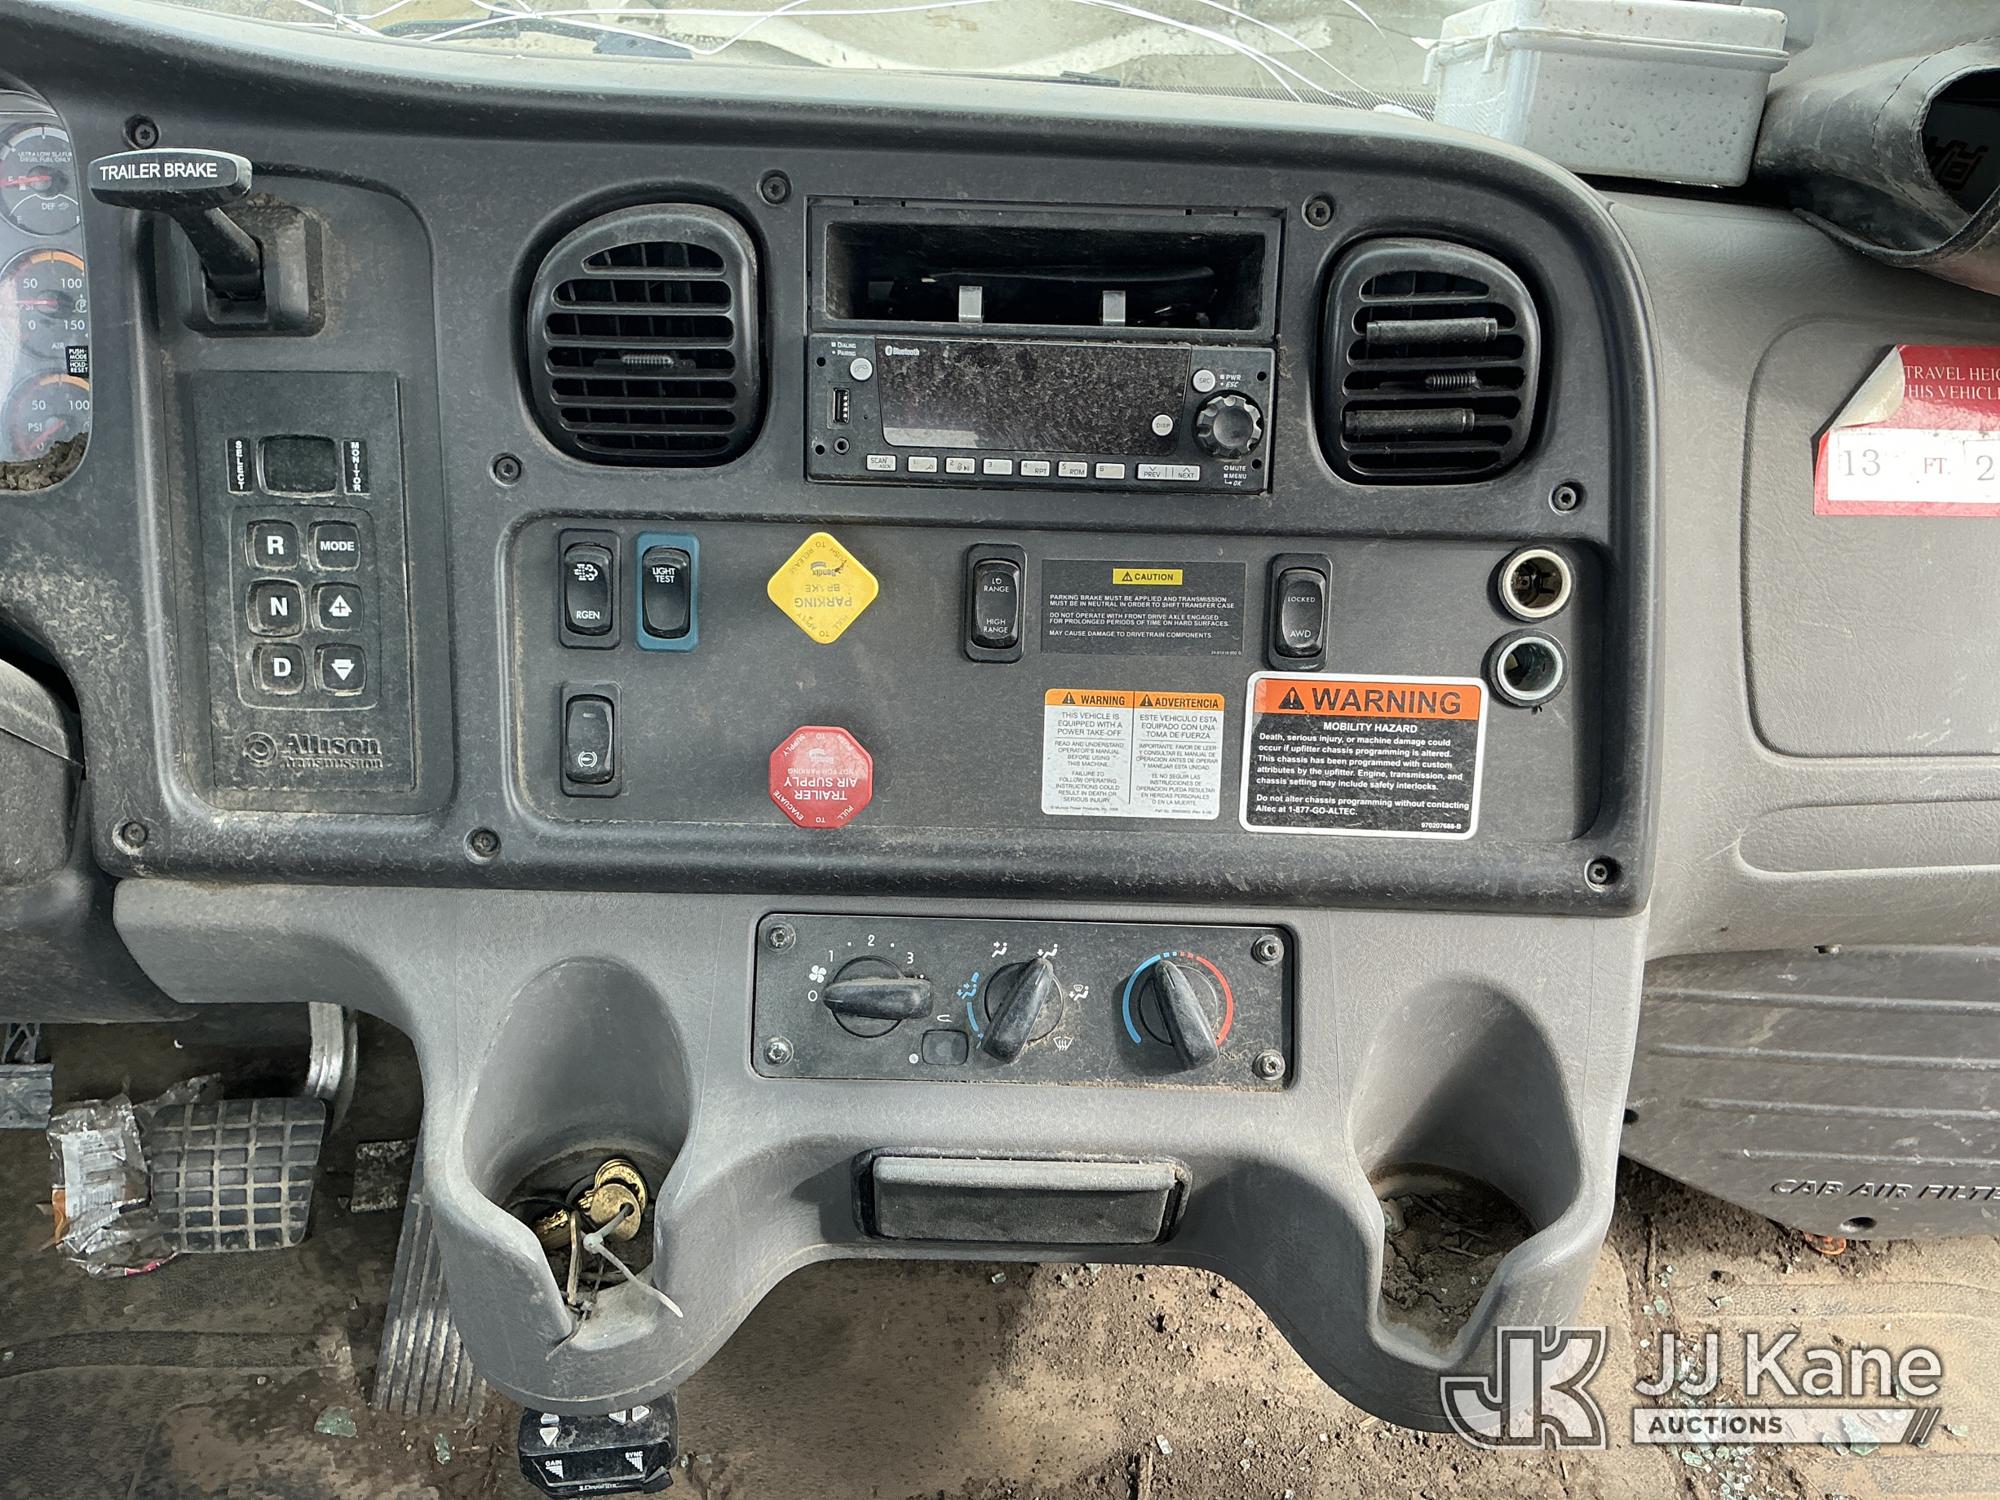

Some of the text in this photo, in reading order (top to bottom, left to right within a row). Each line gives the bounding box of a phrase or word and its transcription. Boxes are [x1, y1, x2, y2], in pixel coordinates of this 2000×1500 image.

[100, 162, 218, 181] TRAILER BRAKE
[41, 202, 55, 210] DEF
[23, 278, 38, 288] 50
[61, 278, 83, 288] 100
[28, 320, 36, 330] 0
[63, 320, 86, 330] 150
[1904, 365, 1966, 380] TRAVEL
[31, 400, 46, 410] 50
[69, 400, 90, 410] 100
[27, 422, 43, 432] PSI
[235, 440, 245, 490] SELECT
[350, 441, 362, 492] MONITOR
[1843, 449, 1881, 477] 13
[1976, 455, 1996, 481] 2
[266, 535, 285, 555] R
[320, 540, 355, 551] MODE
[652, 567, 676, 576] LIGHT
[1134, 572, 1174, 582] CAUTION
[655, 575, 675, 583] TEST
[983, 585, 1010, 593] RANGE
[270, 597, 289, 617] N
[794, 597, 853, 608] PARKING
[576, 611, 601, 620] RGEN
[986, 618, 1006, 626] HIGH
[983, 626, 1009, 634] RANGE
[1289, 629, 1312, 638] AWD
[273, 657, 292, 677] D
[1080, 695, 1125, 706] WARNING
[1154, 697, 1219, 709] ADVERTENCIA
[1311, 687, 1461, 715] WARNING
[1323, 721, 1418, 734] MOBILITY HAZARD
[282, 733, 382, 756] Allison
[783, 733, 806, 757] SUPPLY
[1259, 732, 1285, 742] Death,
[1319, 735, 1345, 744] injury,
[1356, 736, 1391, 744] machine
[1393, 737, 1426, 747] damage
[1427, 739, 1451, 747] could
[1283, 744, 1290, 752] if
[1291, 744, 1321, 753] upfitter
[1321, 746, 1354, 754] chassis
[1355, 747, 1410, 758] programming
[1421, 749, 1453, 757] altered.
[1257, 754, 1453, 769] This chassis has been programmed with custom
[1256, 766, 1295, 774] attributes
[1297, 767, 1307, 776] by
[1309, 767, 1323, 775] the
[1324, 768, 1356, 777] upfitter.
[1357, 769, 1388, 778] Engine,
[1390, 770, 1446, 780] transmission,
[783, 776, 858, 788] AIR SUPPLY
[1256, 776, 1439, 791] chassis setting may include safety interlocks.
[794, 790, 848, 800] TRAILER
[773, 789, 805, 821] EVACUATE
[1256, 793, 1470, 811] Do not alter chassis programming without contacting
[837, 805, 854, 820] PULL
[1255, 805, 1277, 813] Altec
[1288, 806, 1358, 816] 1-877-GO-ALTEC.
[867, 934, 876, 947] 2
[828, 949, 834, 963] 1
[906, 951, 914, 964] 3
[1771, 1178, 1843, 1196] CAB
[1848, 1181, 1913, 1198] AIR
[544, 1459, 563, 1467] GAIN
